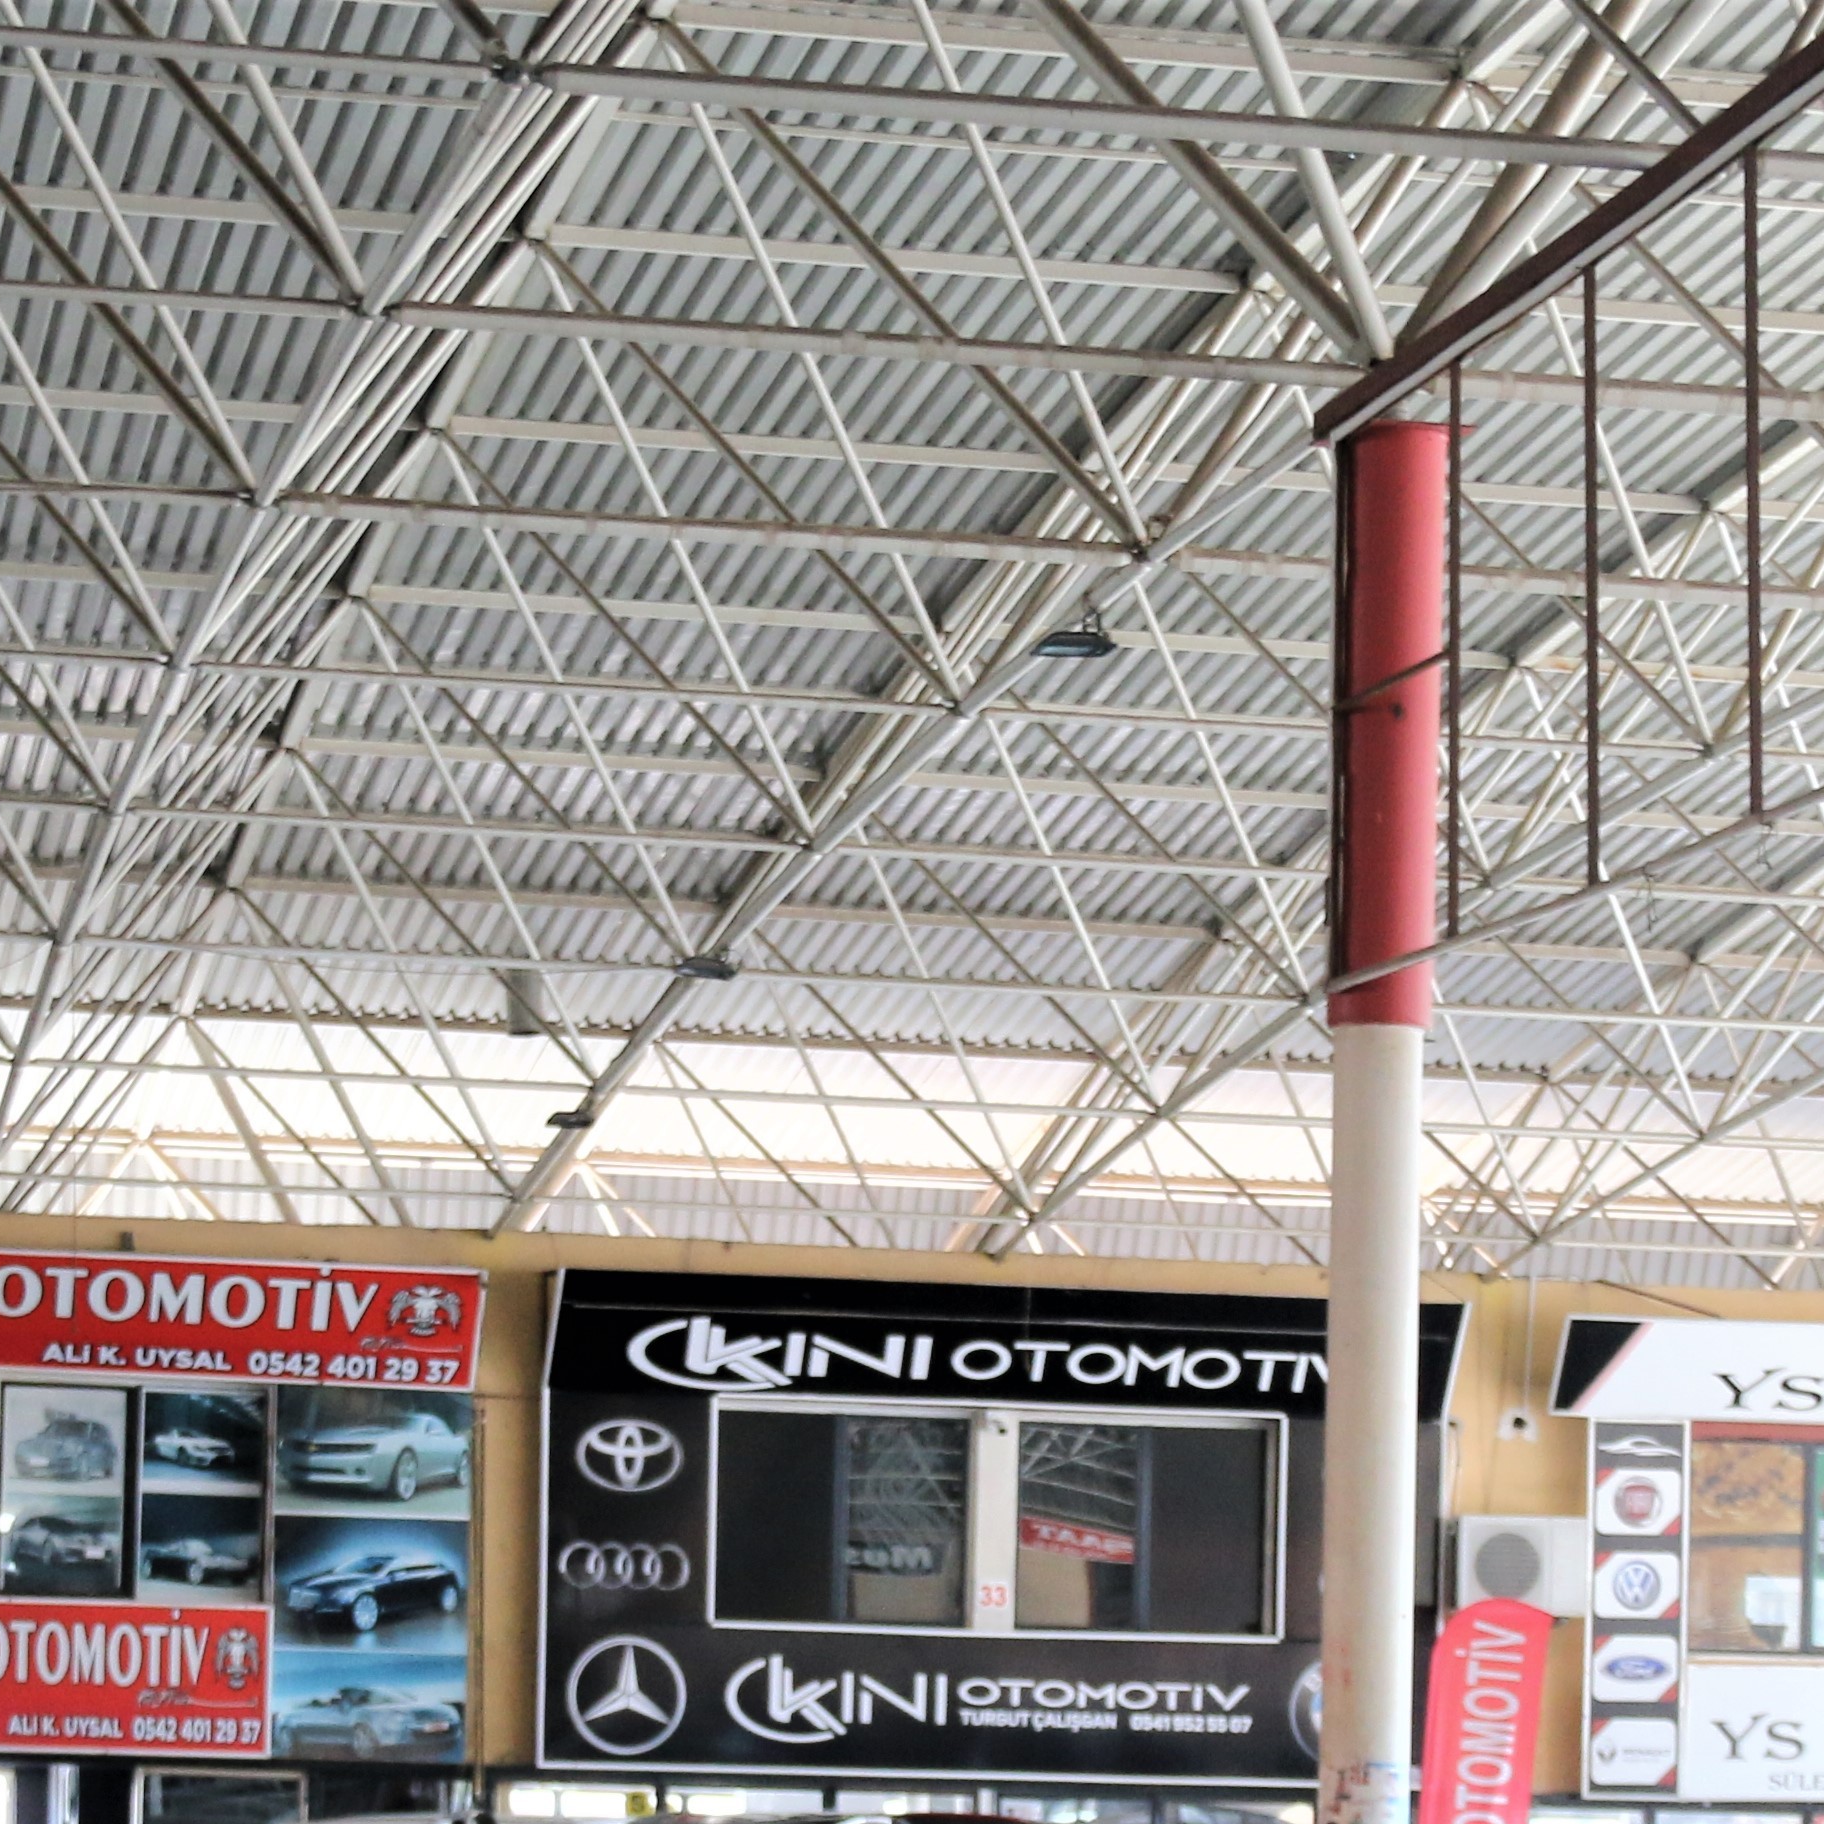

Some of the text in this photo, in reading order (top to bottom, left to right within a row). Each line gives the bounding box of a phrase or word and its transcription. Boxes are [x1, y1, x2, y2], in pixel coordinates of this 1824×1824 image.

[98, 1344, 125, 1367] K.
[134, 1346, 231, 1371] UYSAL
[248, 1350, 320, 1378] 0542
[328, 1354, 376, 1380] 401
[383, 1357, 419, 1382] 29
[426, 1359, 460, 1384] 37
[980, 1585, 1008, 1608] 33
[64, 1715, 123, 1739] UYSAL
[132, 1717, 177, 1742] 0542
[181, 1718, 212, 1743] 401
[215, 1719, 237, 1744] 29
[241, 1719, 262, 1745] 37
[959, 1708, 1028, 1728] TURGUT
[1711, 1713, 1806, 1764] YS
